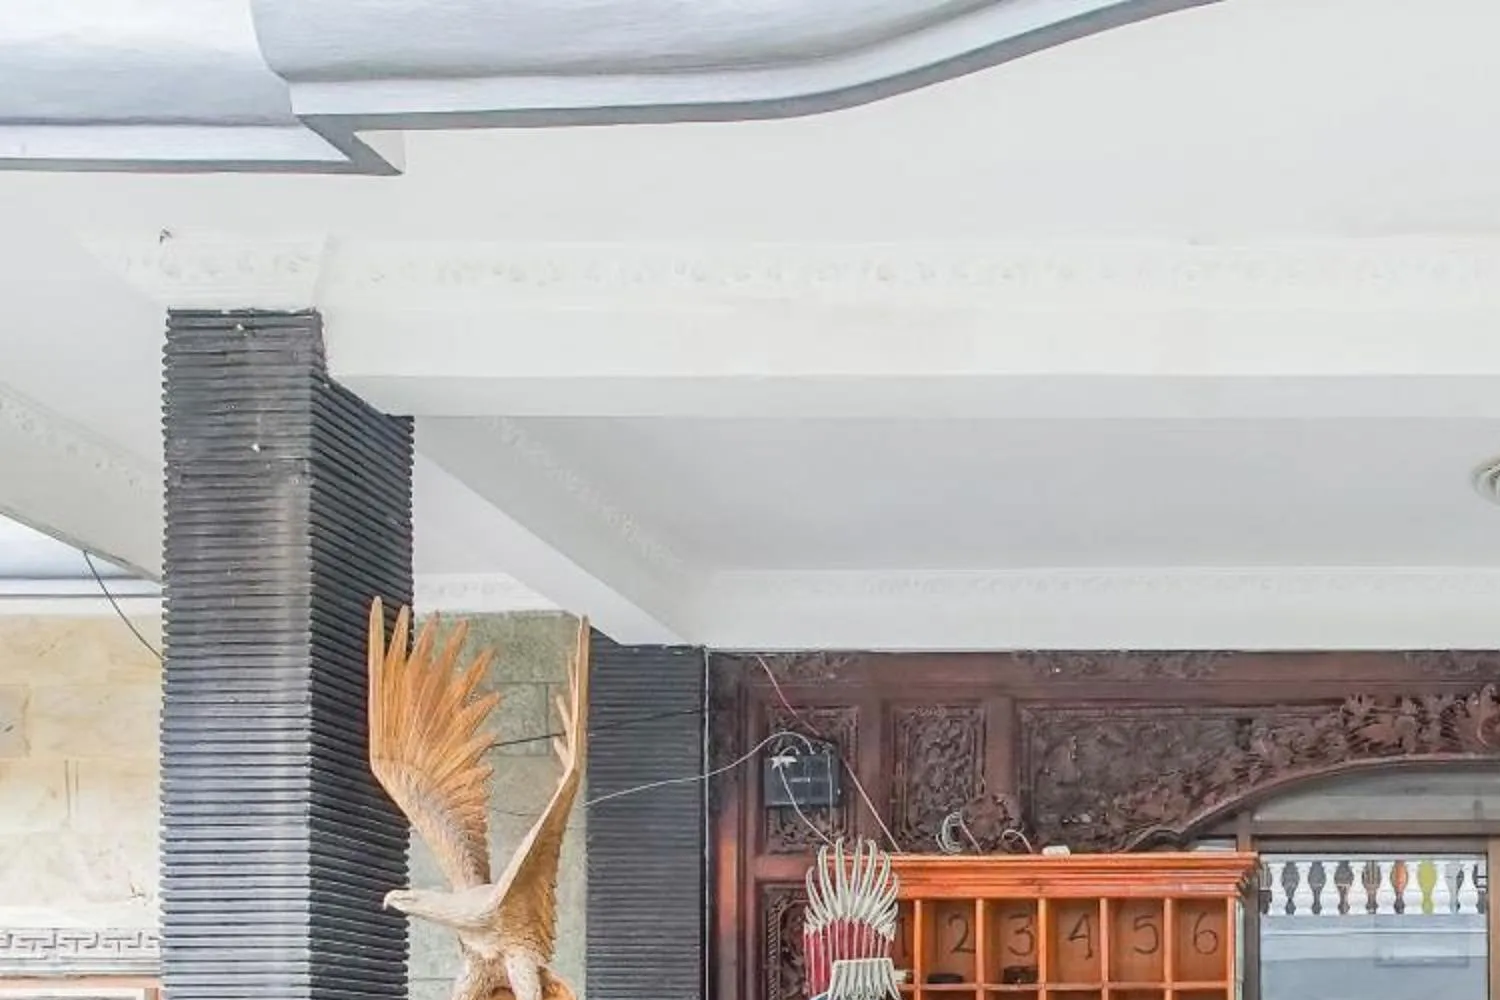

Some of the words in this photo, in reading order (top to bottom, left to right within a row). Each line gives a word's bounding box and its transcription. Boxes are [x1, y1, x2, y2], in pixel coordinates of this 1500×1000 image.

[948, 913, 977, 954] 2
[1008, 913, 1035, 956] 3
[1068, 913, 1093, 960] 4
[1133, 914, 1159, 955] 5
[1193, 911, 1219, 955] 6
